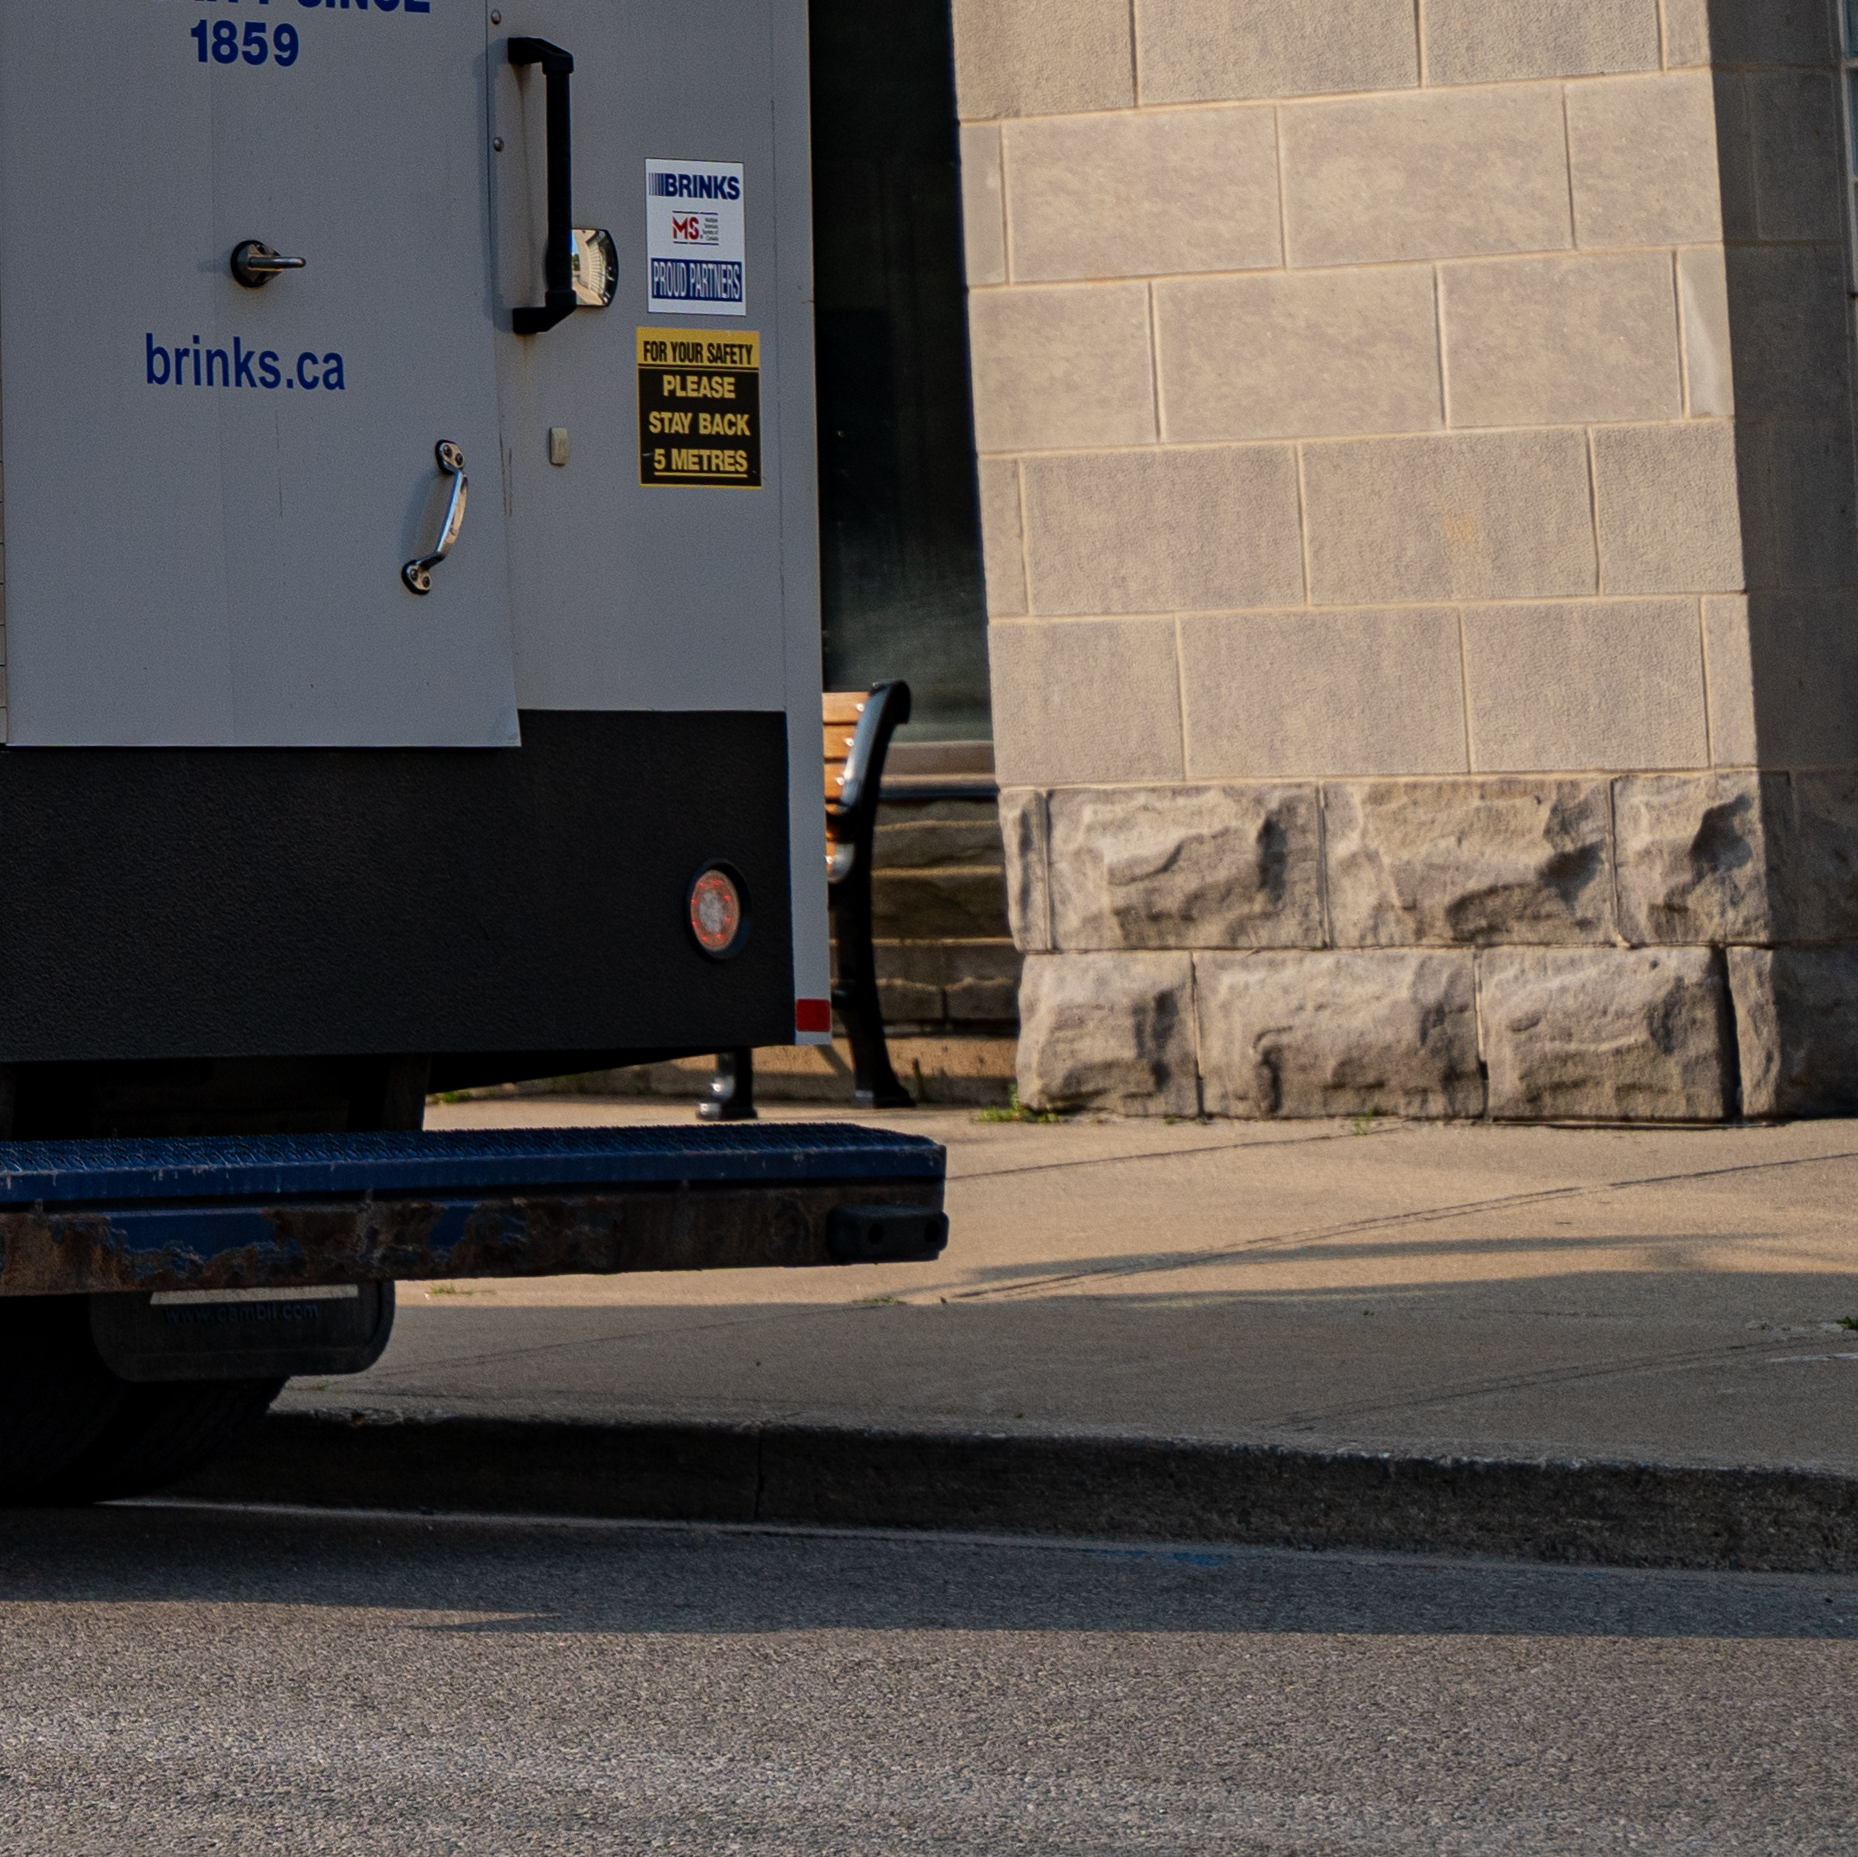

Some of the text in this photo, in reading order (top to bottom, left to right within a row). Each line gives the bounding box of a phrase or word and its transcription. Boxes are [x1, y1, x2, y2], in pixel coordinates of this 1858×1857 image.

[189, 18, 300, 68] 1859
[662, 172, 741, 201] BRINKS
[653, 260, 741, 300] PROUD PARTNERS
[145, 331, 346, 391] brinks.ca
[642, 340, 753, 365] FOR YOUR SAFETY
[662, 374, 736, 400] PLEASE
[648, 412, 751, 437] STAY BACK
[653, 447, 749, 473] 5 METRES
